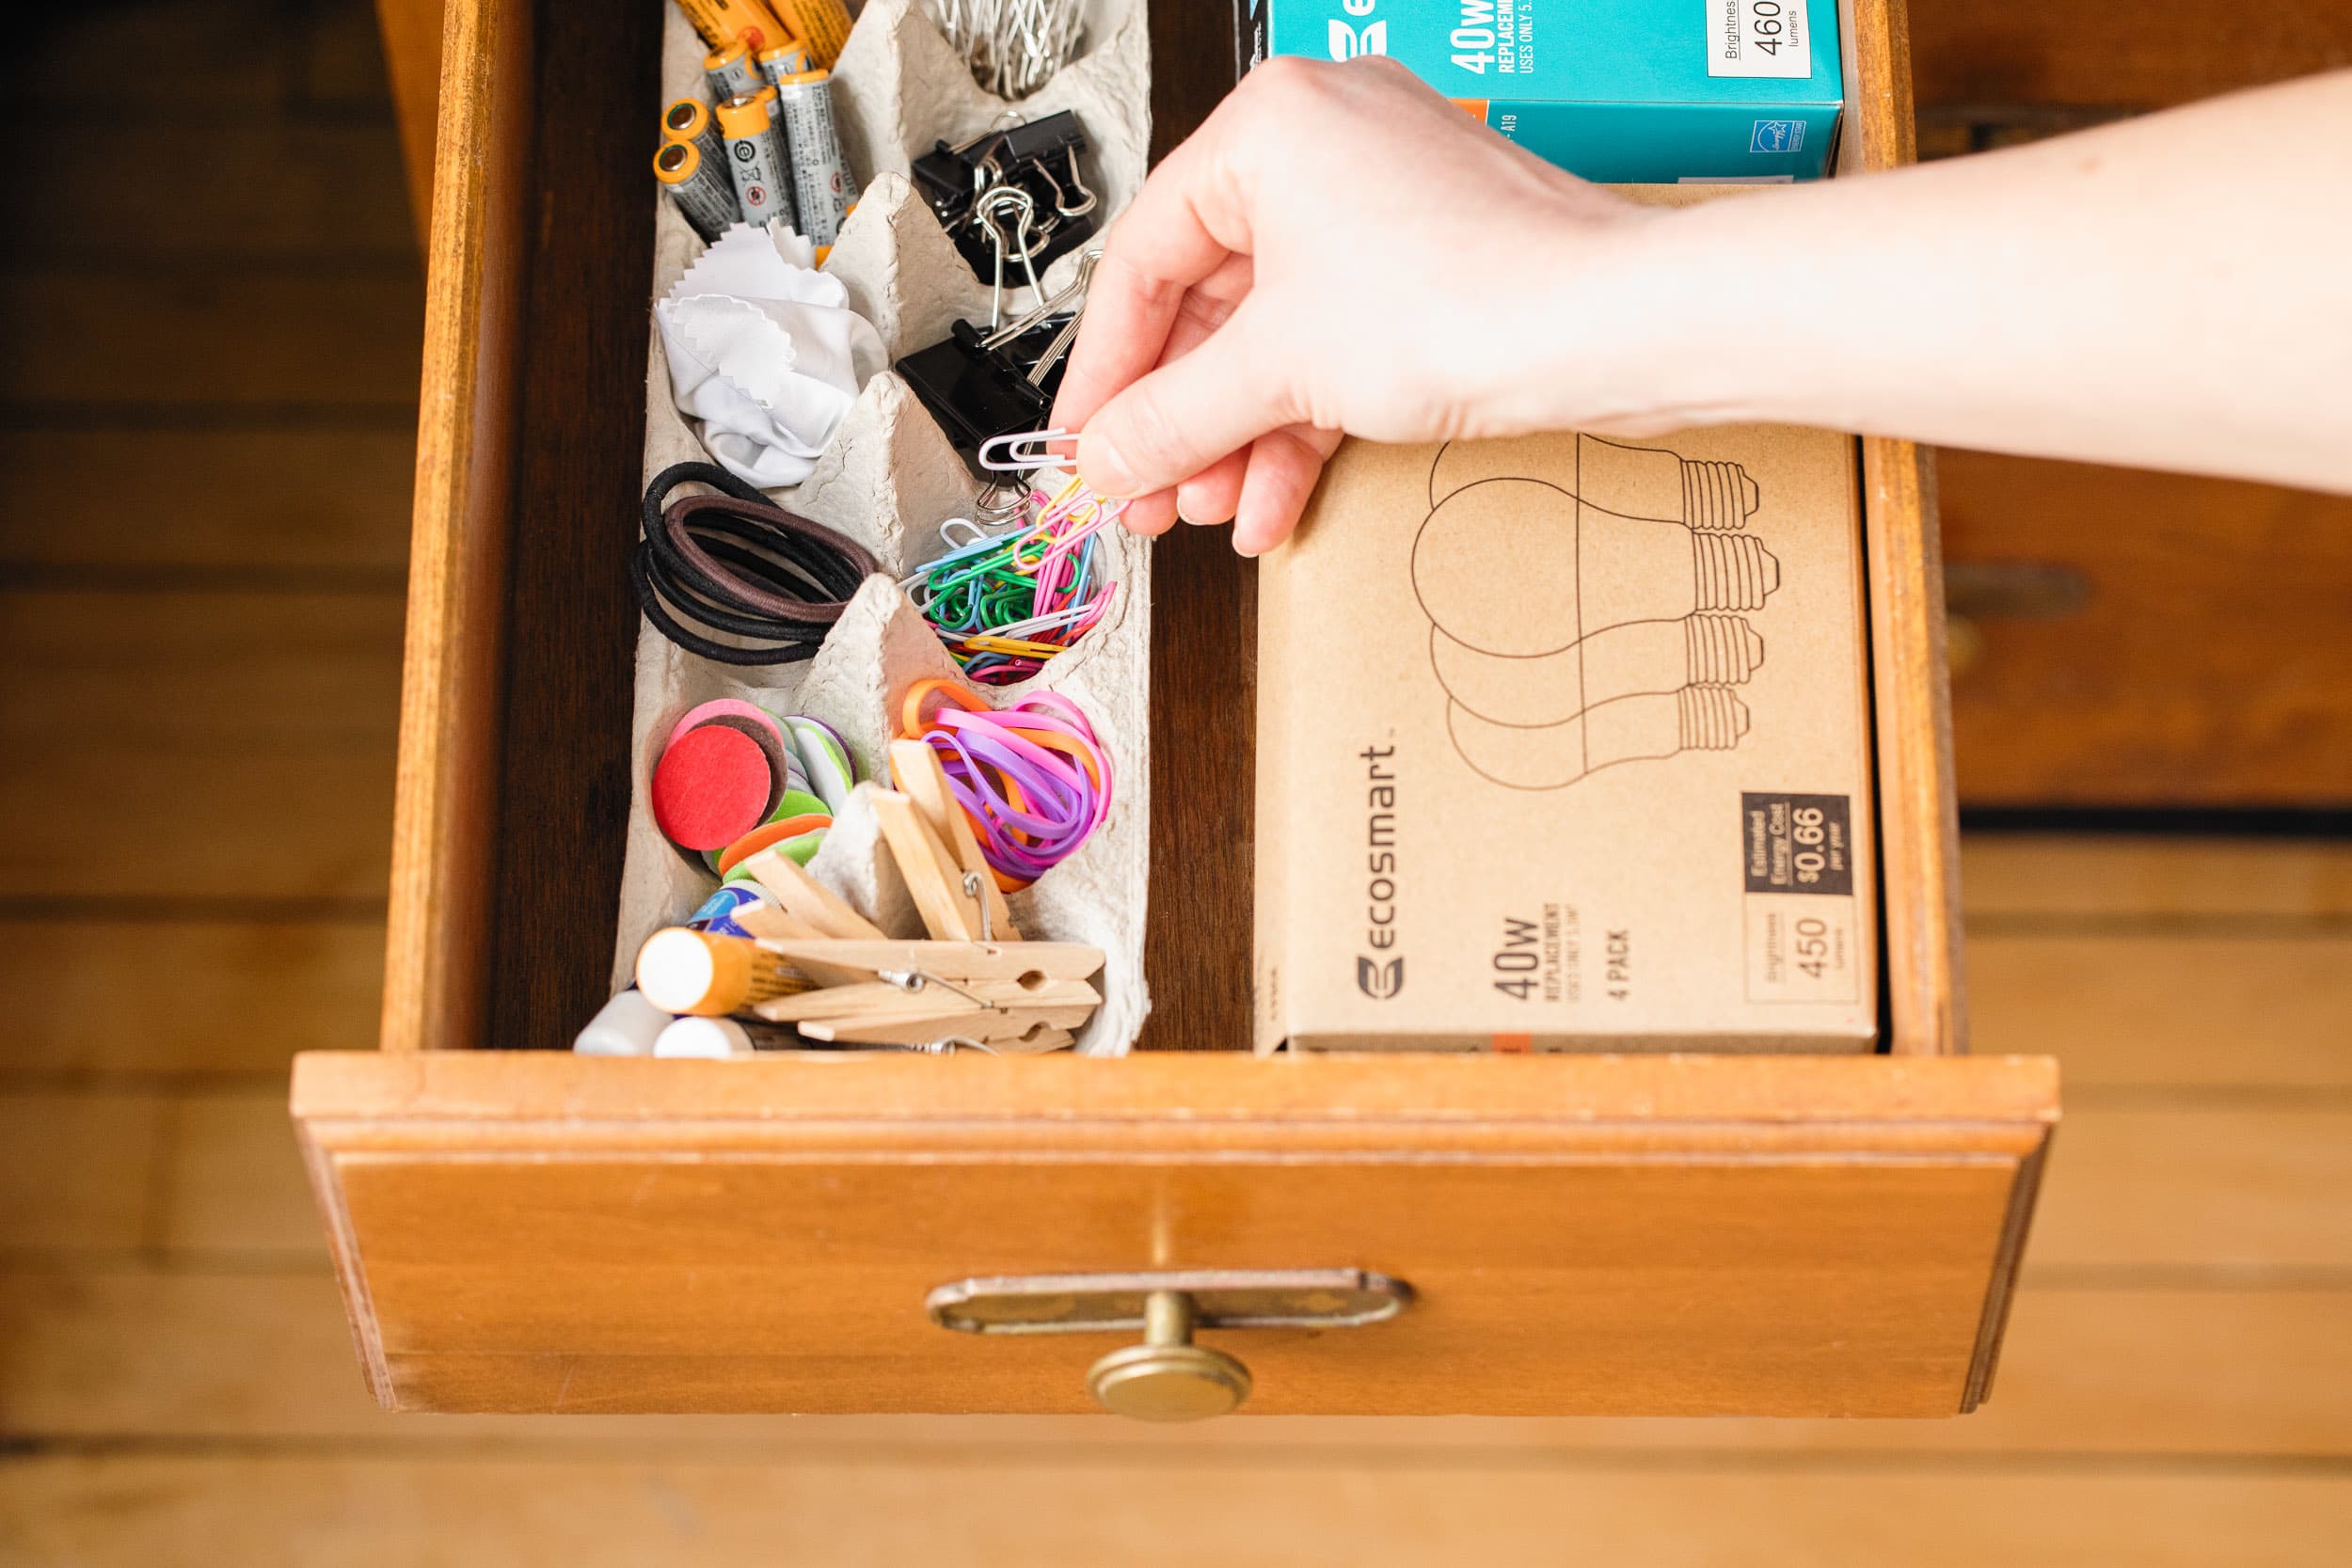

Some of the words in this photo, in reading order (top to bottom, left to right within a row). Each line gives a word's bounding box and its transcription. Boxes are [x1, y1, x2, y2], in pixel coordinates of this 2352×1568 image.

[1497, 0, 1516, 73] REPLACEM
[1518, 14, 1534, 42] ONLY
[1724, 0, 1740, 59] Brightnes
[1753, 1, 1783, 55] 460
[1788, 10, 1800, 47] lumens
[1518, 44, 1534, 73] USES
[1501, 114, 1518, 132] A19
[1750, 810, 1769, 878] Estimated
[1769, 803, 1786, 836] Cost
[1792, 807, 1826, 883] $0.66
[1359, 745, 1395, 950] ecosmart
[1770, 836, 1788, 885] Energy
[1607, 928, 1630, 982] PACK
[1795, 917, 1828, 978] 450
[1608, 989, 1629, 1002] 4
